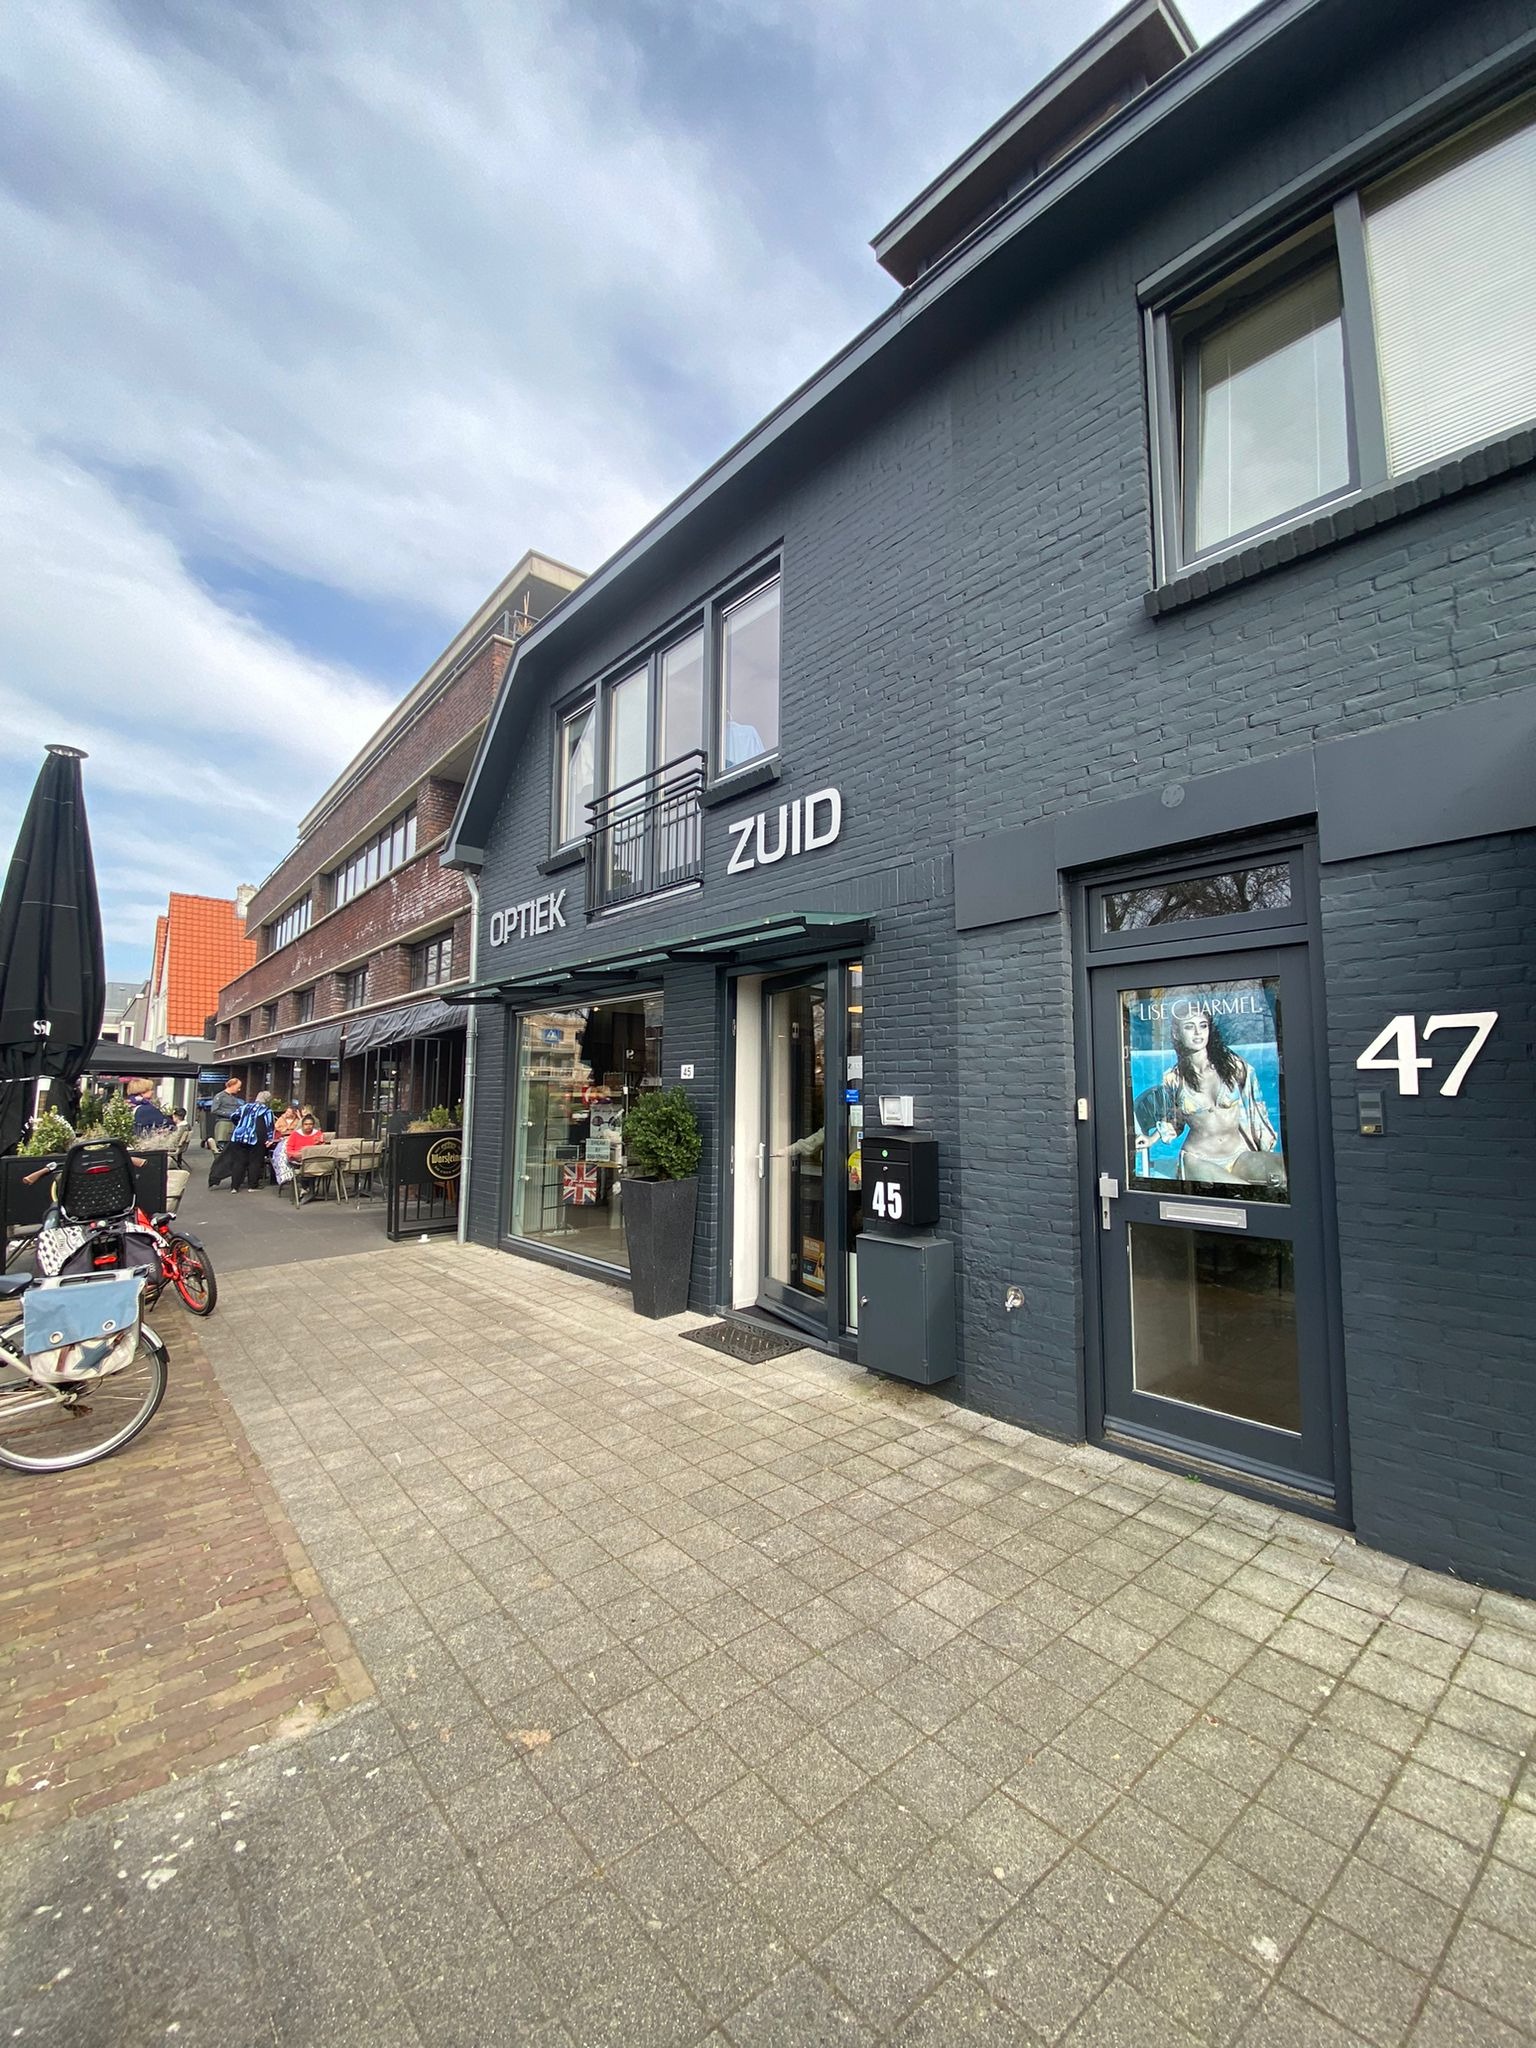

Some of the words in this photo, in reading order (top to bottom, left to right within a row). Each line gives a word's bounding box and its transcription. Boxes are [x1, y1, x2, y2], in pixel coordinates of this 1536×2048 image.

[727, 787, 842, 875] ZUID
[489, 888, 567, 947] OPTIEK
[1140, 1002, 1169, 1021] LISE
[1171, 996, 1263, 1021] CHARMEL
[683, 1066, 692, 1077] 45
[1356, 1011, 1498, 1097] 47
[872, 1181, 903, 1220] 45
